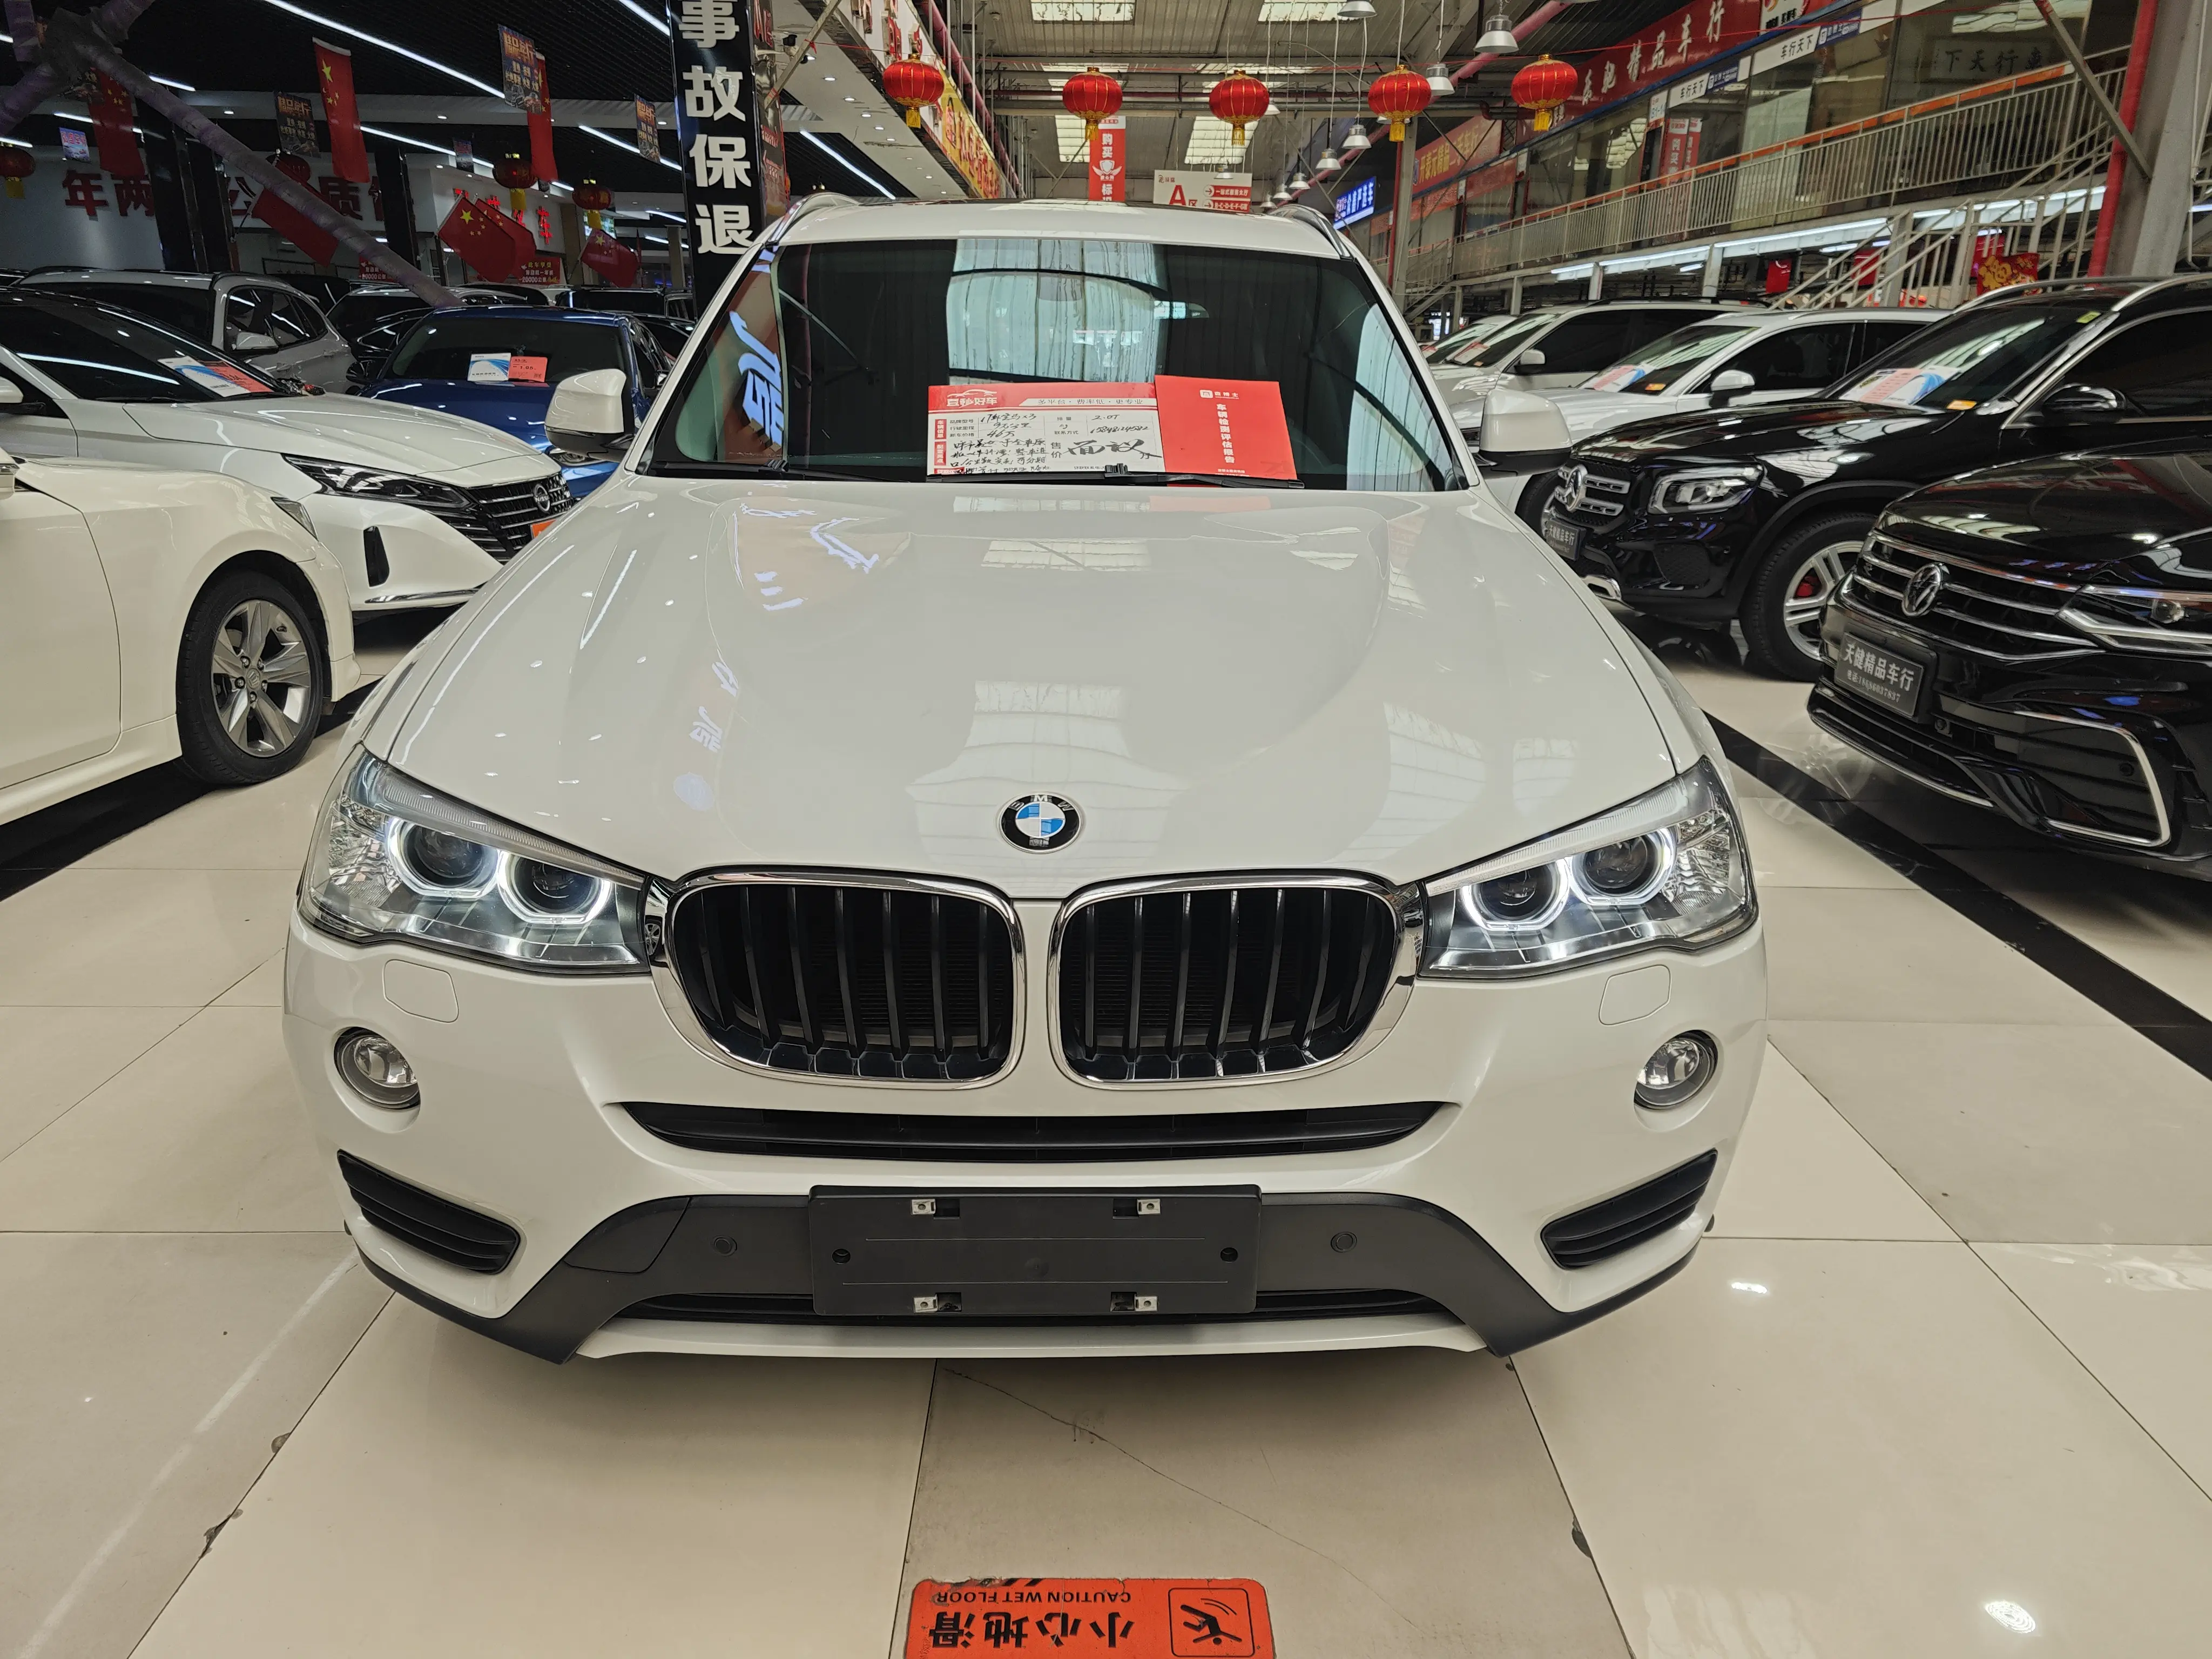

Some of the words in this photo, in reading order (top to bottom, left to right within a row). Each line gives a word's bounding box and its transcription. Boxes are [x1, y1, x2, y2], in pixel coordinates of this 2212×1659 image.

[1781, 35, 1813, 59] 车行天下
[1680, 79, 1704, 99] 车行天下
[1216, 404, 1235, 464] 车辆检测评估报告
[1051, 442, 1062, 458] 售价
[1843, 643, 1914, 691] 天健精品车行
[1009, 795, 1074, 811] BMW
[937, 1591, 997, 1603] FLOOR
[1002, 1591, 1042, 1602] WET
[1048, 1591, 1131, 1603] CAUTION
[929, 1611, 1134, 1648] 小心地滑
